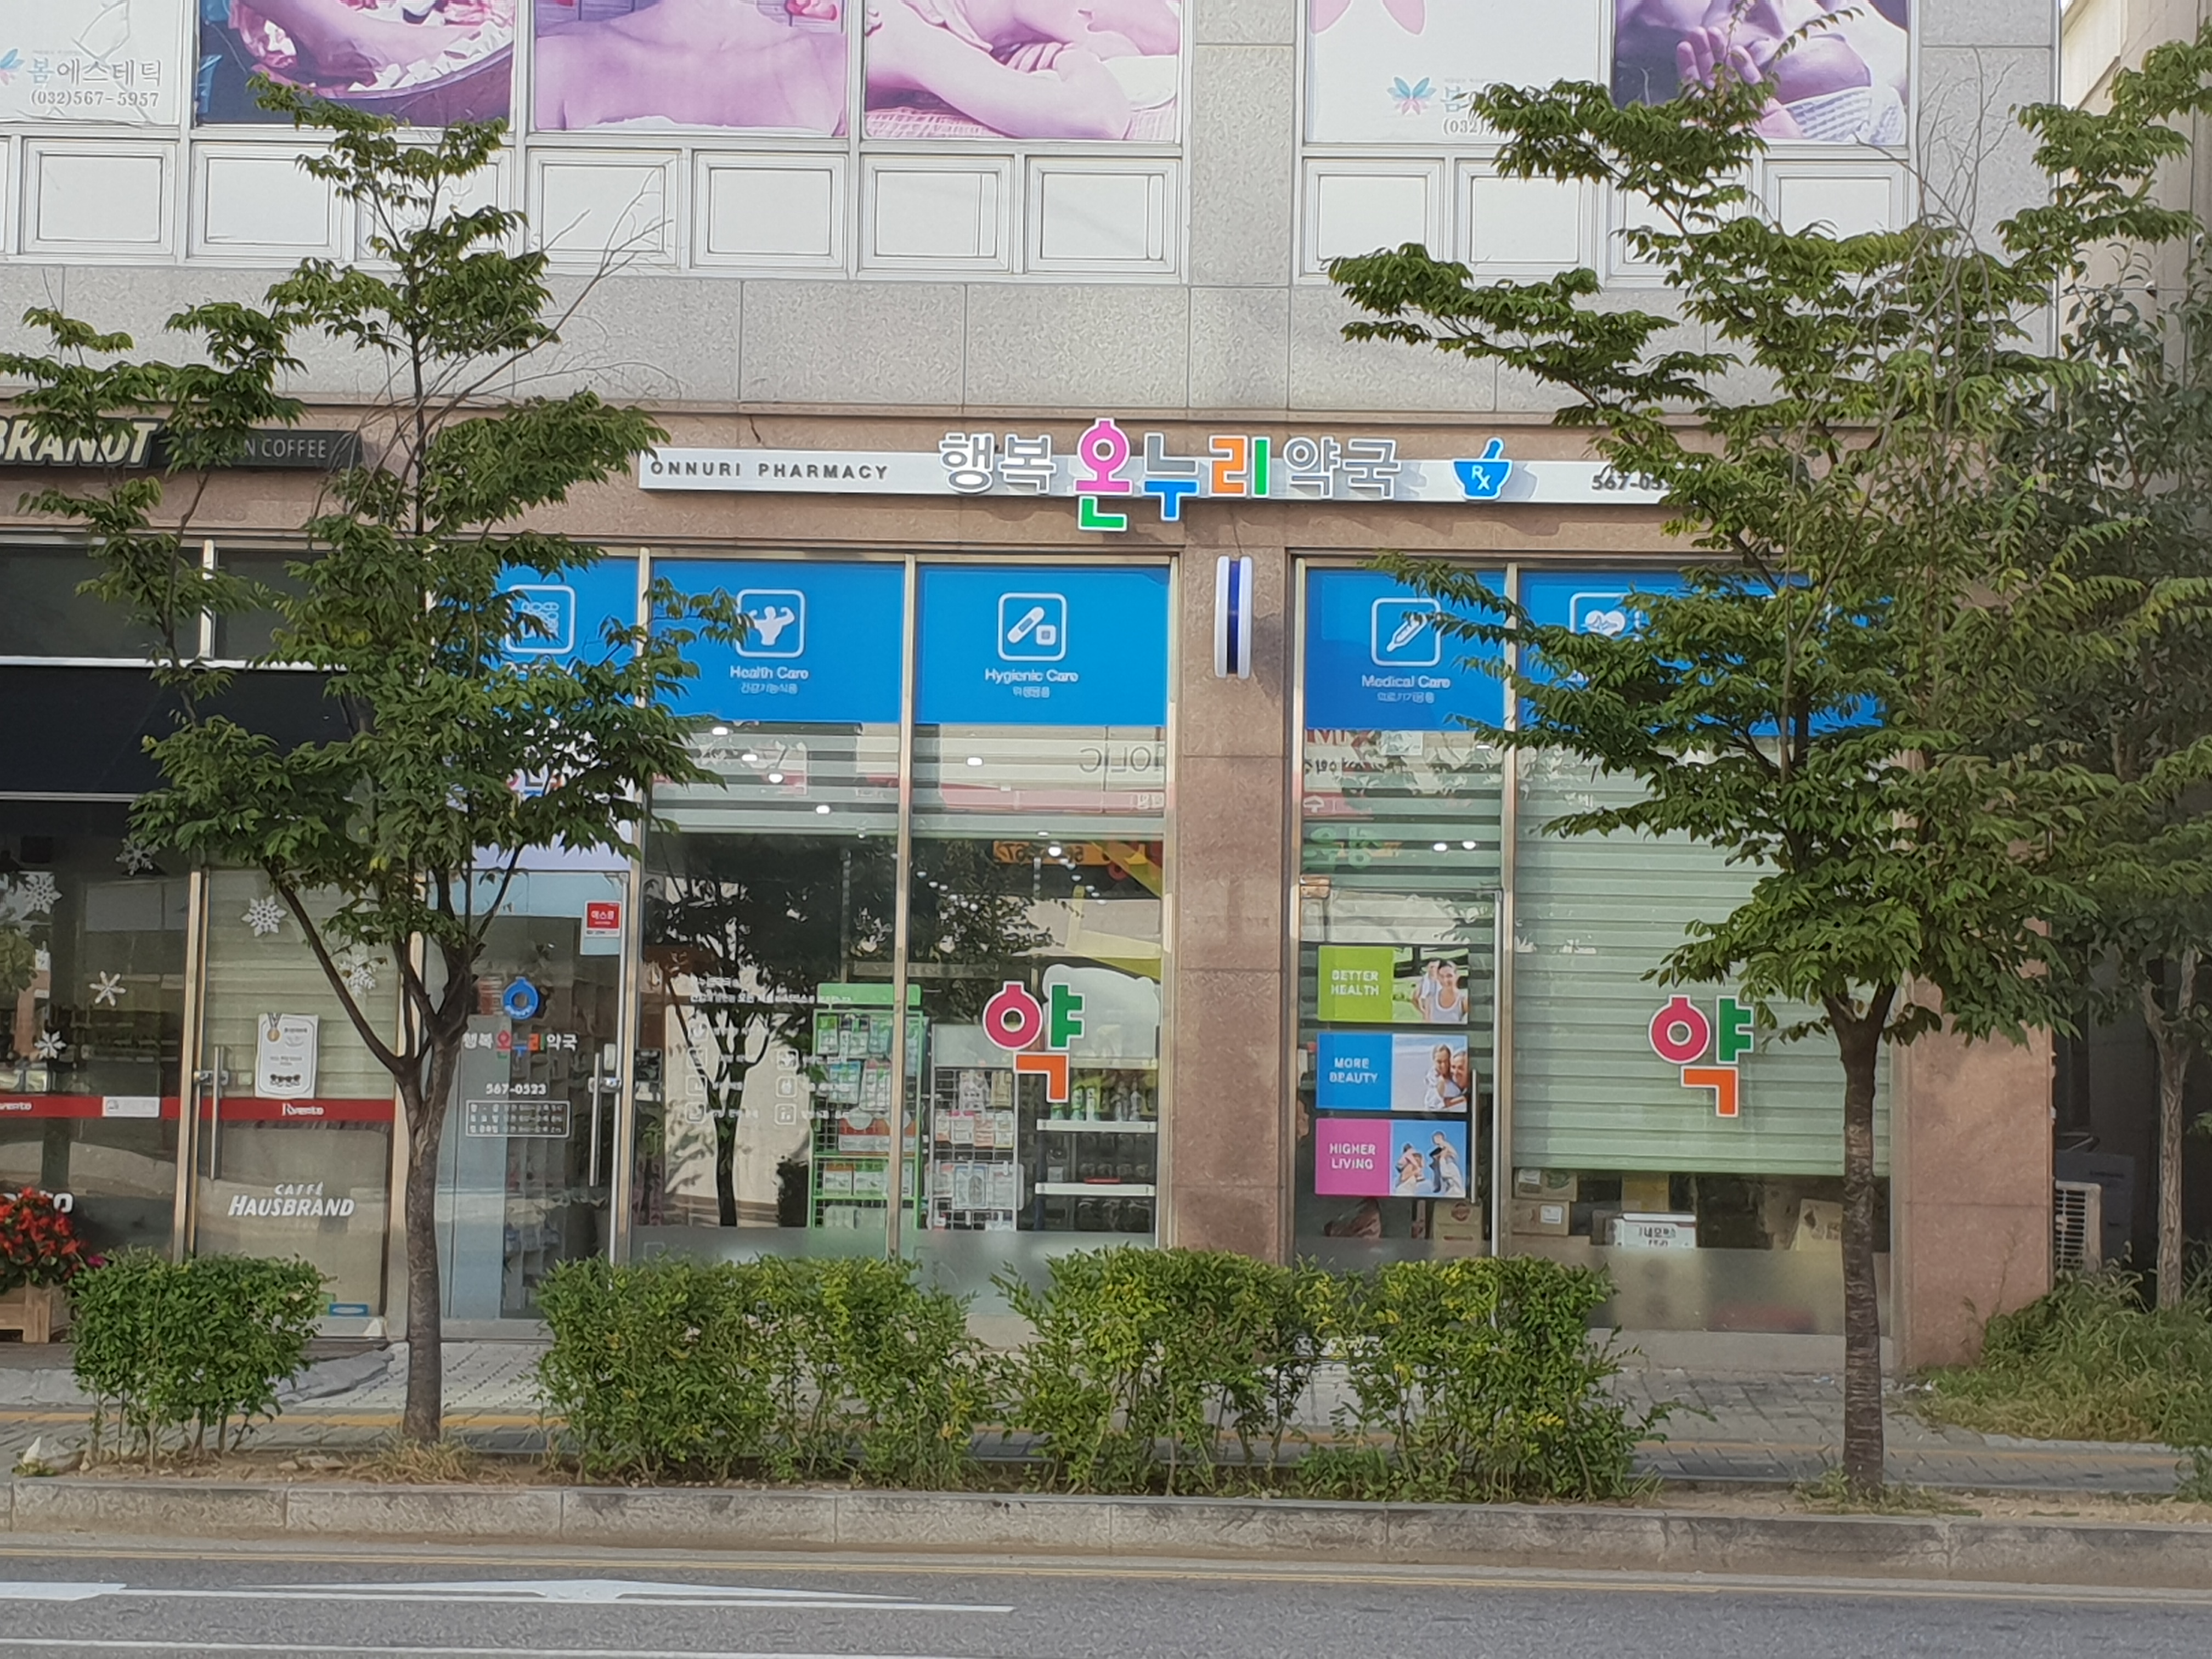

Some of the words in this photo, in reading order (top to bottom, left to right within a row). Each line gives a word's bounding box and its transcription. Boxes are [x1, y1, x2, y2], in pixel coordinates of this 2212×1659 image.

[27, 58, 161, 87] 봄에스테틱
[31, 90, 159, 107] (032)567-5957
[262, 439, 326, 458] COFFEE
[651, 461, 741, 477] ONNURI
[758, 463, 888, 479] PHARMACY
[730, 665, 774, 679] Health
[776, 666, 809, 680] Care
[985, 668, 1043, 685] Hygienic
[1046, 669, 1079, 682] Care
[1362, 675, 1415, 687] Medical
[1418, 675, 1451, 689] Care
[1331, 969, 1379, 981] BETTER
[1331, 984, 1379, 996] HEALTH
[983, 980, 1085, 1104] 약
[1334, 1057, 1370, 1069] MORE
[1648, 994, 1755, 1118] 약
[1329, 1071, 1378, 1084] BEAUTY
[1329, 1142, 1376, 1155] HIGHER
[1331, 1158, 1374, 1170] LIVING
[228, 1194, 355, 1217] HAUSBRAND
